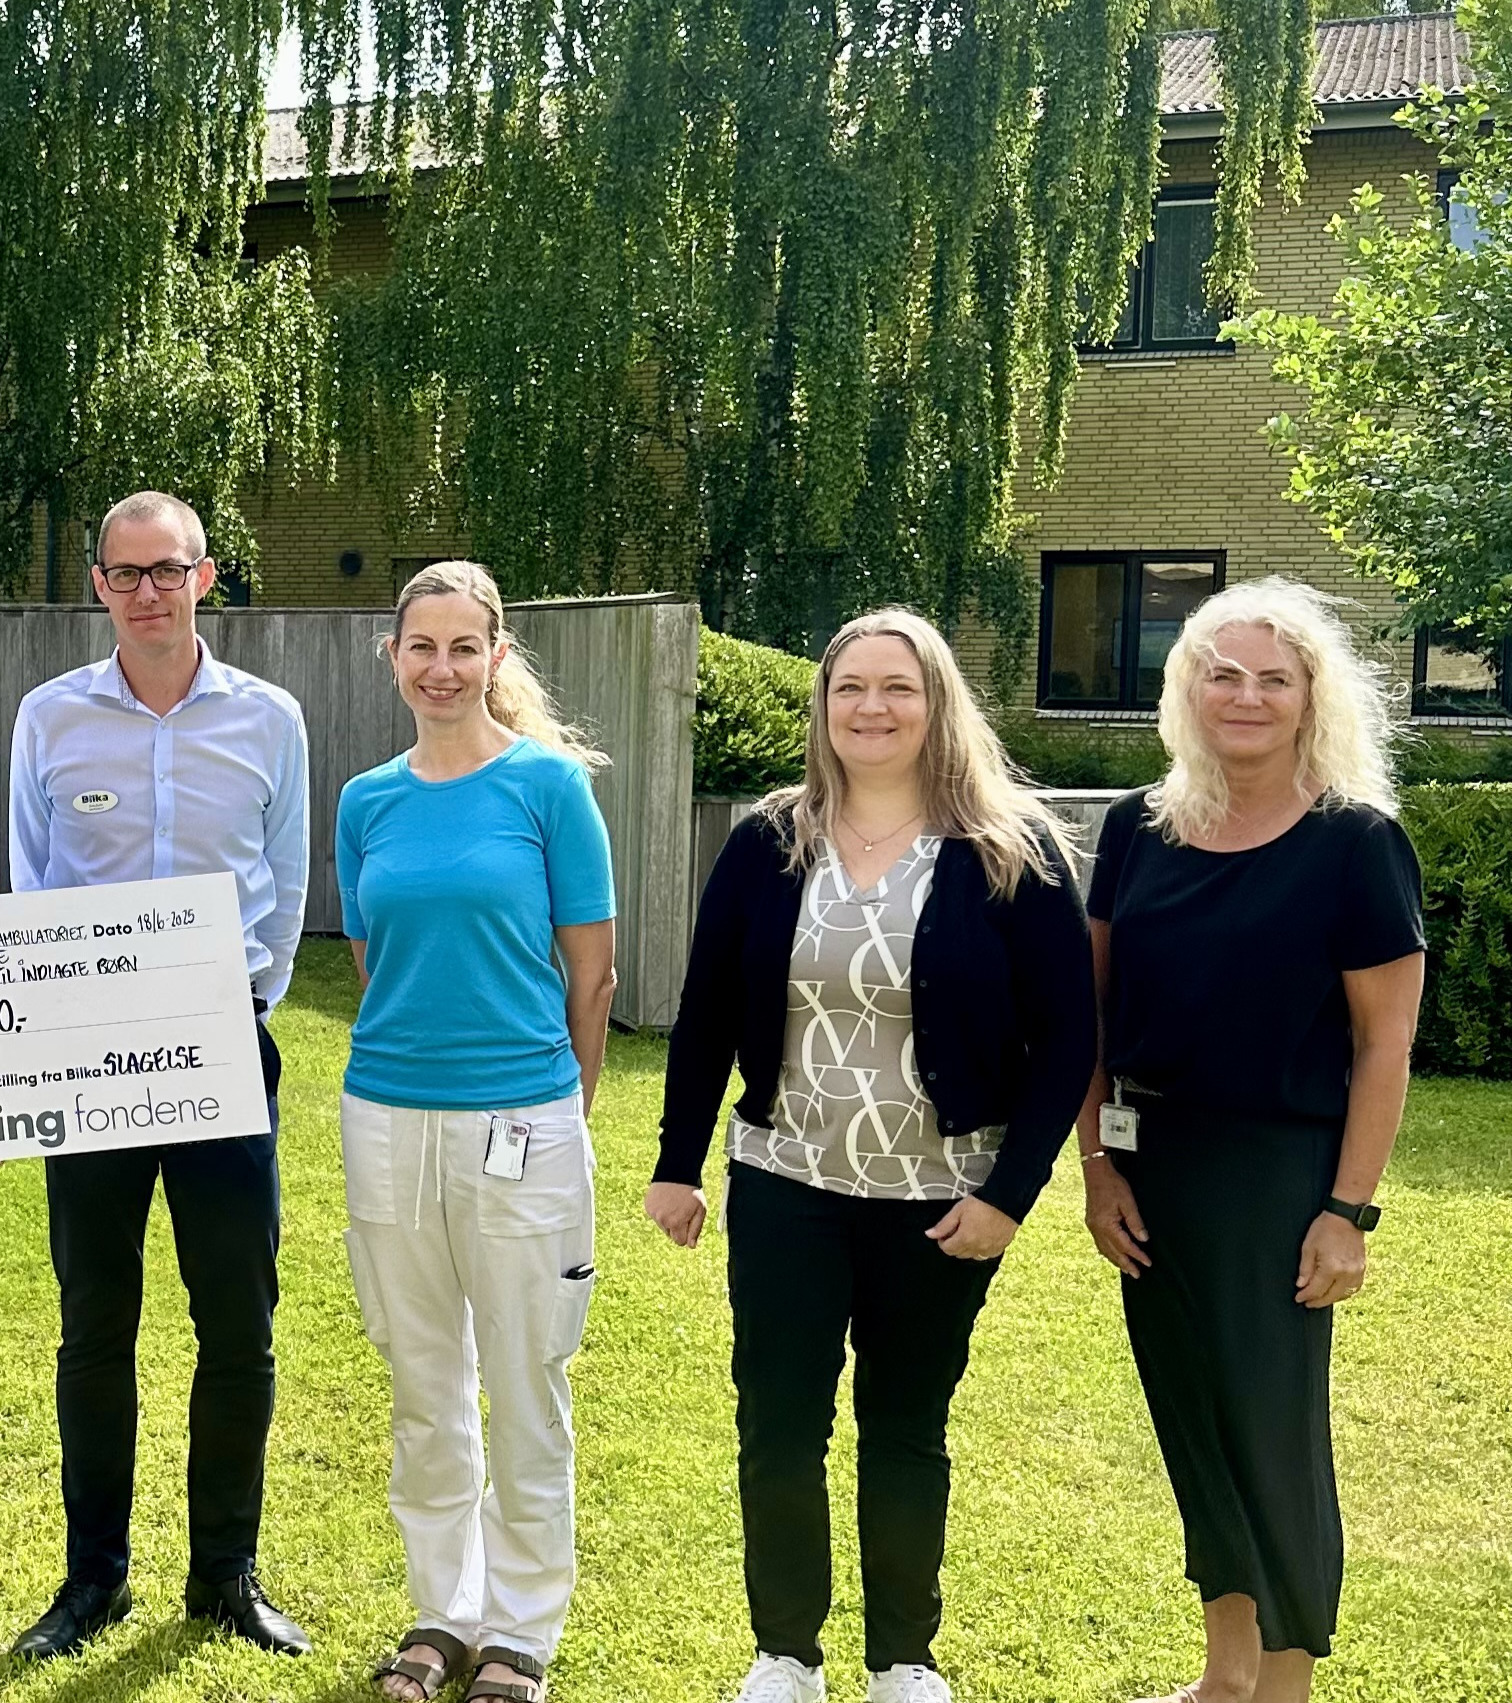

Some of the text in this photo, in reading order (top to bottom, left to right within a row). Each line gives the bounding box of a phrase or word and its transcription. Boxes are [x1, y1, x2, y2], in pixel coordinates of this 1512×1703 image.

[81, 794, 109, 804] Bilka
[92, 924, 133, 938] Dato
[96, 954, 138, 975] BØRN
[102, 1045, 204, 1077] SLAGELSE
[41, 1070, 62, 1084] fra
[66, 1066, 103, 1081] Bilka
[74, 1087, 221, 1133] fondene
